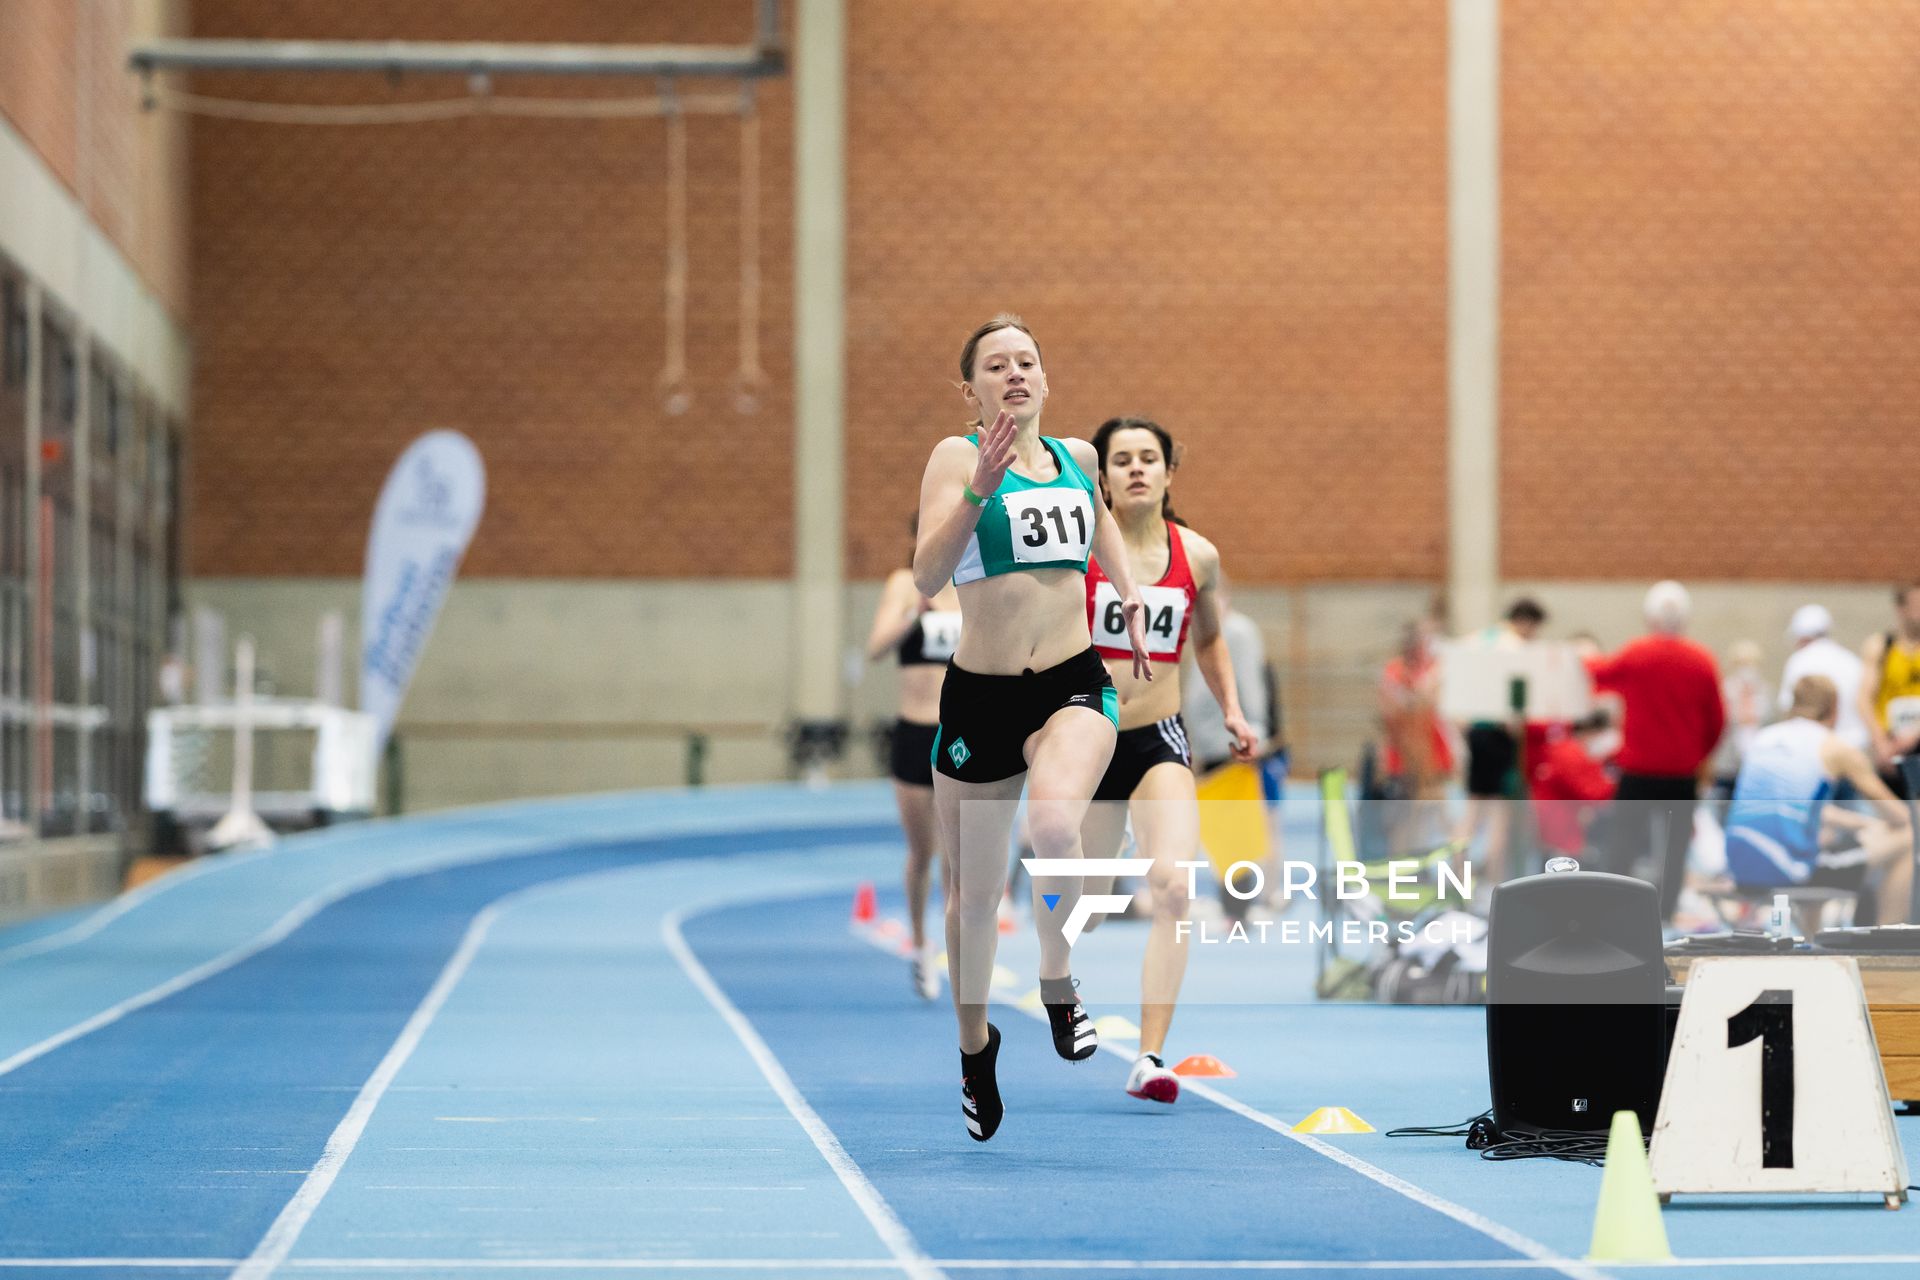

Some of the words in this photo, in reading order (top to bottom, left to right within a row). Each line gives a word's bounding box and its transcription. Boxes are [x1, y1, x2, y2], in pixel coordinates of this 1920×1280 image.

[1020, 505, 1086, 548] 311
[1103, 600, 1174, 638] 64
[1727, 989, 1795, 1169] 1
